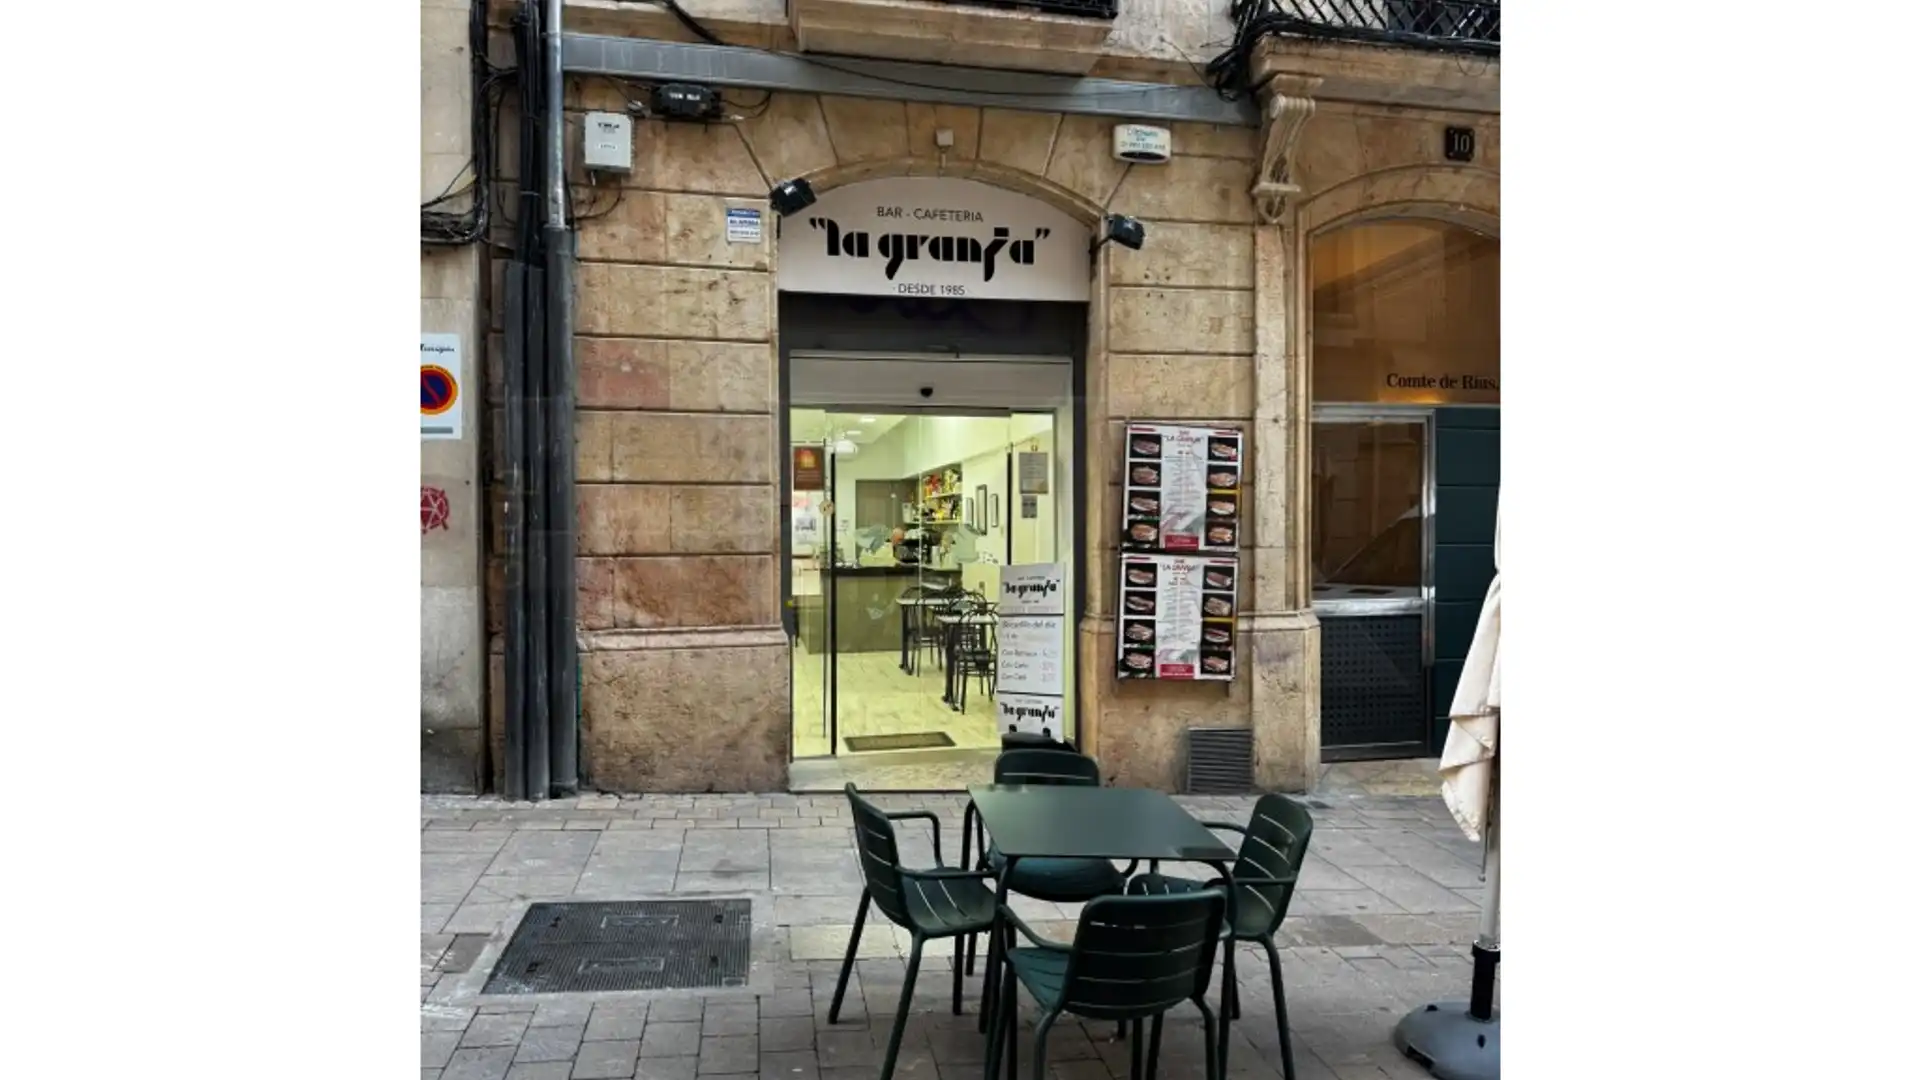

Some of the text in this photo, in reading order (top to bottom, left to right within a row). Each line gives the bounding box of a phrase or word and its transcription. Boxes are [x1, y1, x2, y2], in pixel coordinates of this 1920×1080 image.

[1453, 133, 1471, 153] 10
[876, 206, 902, 218] BAR
[913, 208, 984, 222] CAFETERIA
[898, 283, 965, 296] DESDE 1985
[1386, 373, 1437, 388] Comte
[1440, 374, 1459, 389] de
